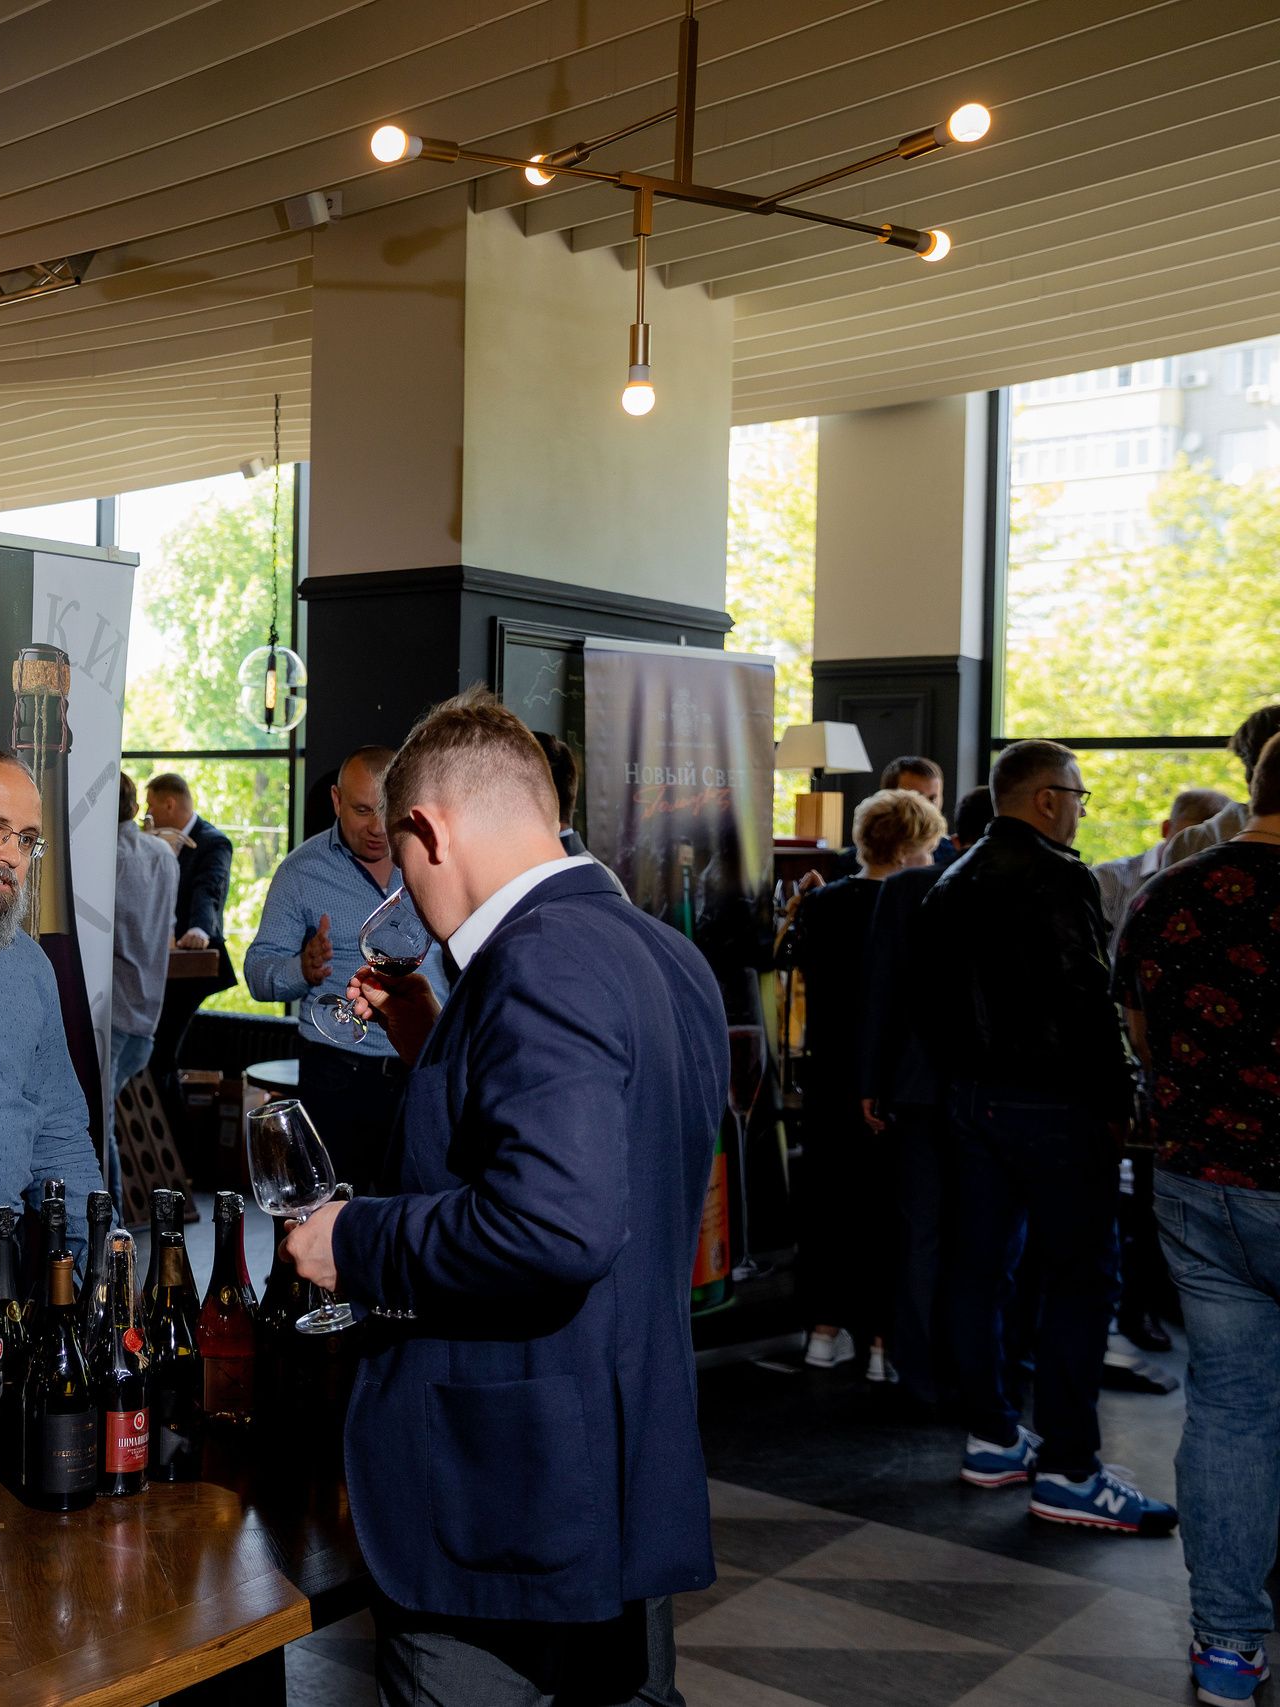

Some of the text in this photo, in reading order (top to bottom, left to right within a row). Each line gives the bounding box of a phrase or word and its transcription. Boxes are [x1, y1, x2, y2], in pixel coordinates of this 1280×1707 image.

[46, 592, 126, 716] КИ
[1093, 1487, 1127, 1515] N
[1209, 1654, 1239, 1667] Reebok
